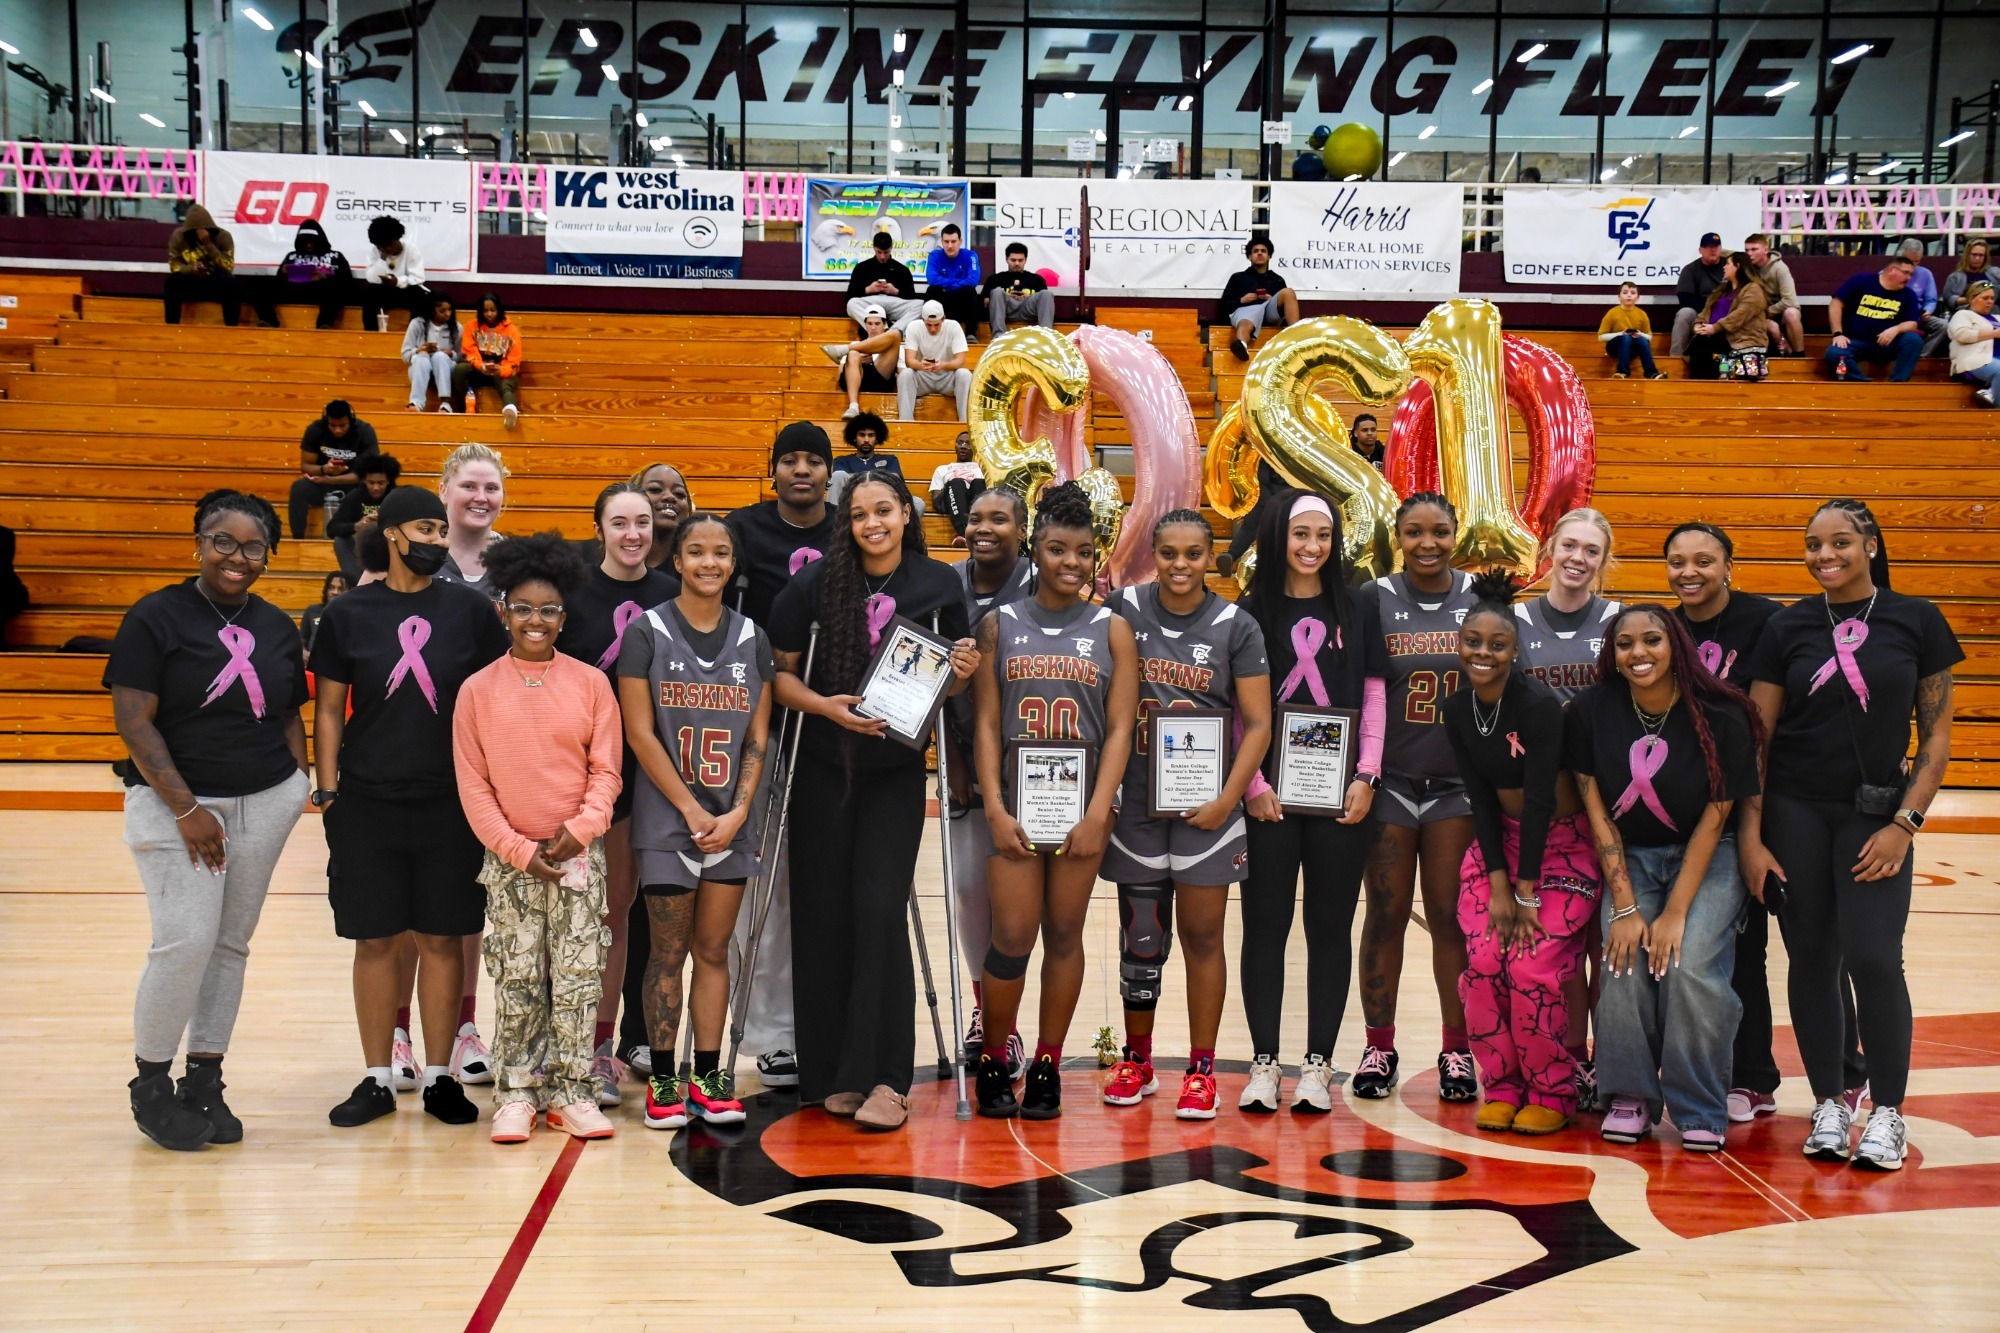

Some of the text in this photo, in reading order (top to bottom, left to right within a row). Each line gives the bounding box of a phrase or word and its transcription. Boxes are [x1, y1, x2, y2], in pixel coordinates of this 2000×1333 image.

[445, 15, 1896, 117] ERSKINE FLYING FLEET
[616, 170, 680, 190] west
[234, 180, 330, 226] GO
[617, 188, 735, 211] carolina
[842, 185, 933, 199] DUE WEST
[335, 213, 358, 222] GOLF
[819, 200, 956, 218] SIGN SHOP
[1000, 203, 1248, 232] SELF REGIONAL
[1321, 187, 1411, 233] Harris
[554, 219, 675, 235] Connect to what you love
[1307, 240, 1424, 254] FUNERAL HOME
[555, 262, 734, 279] Internet Voice TV Business
[1277, 257, 1451, 274] & CREMATION SERVICES
[1512, 264, 1637, 277] CONFERENCE
[1006, 655, 1100, 687] ERSKINE
[1138, 657, 1214, 693] RSKINE
[659, 681, 750, 712] ERSKINE
[1018, 697, 1081, 740] 30
[678, 726, 732, 788] 15
